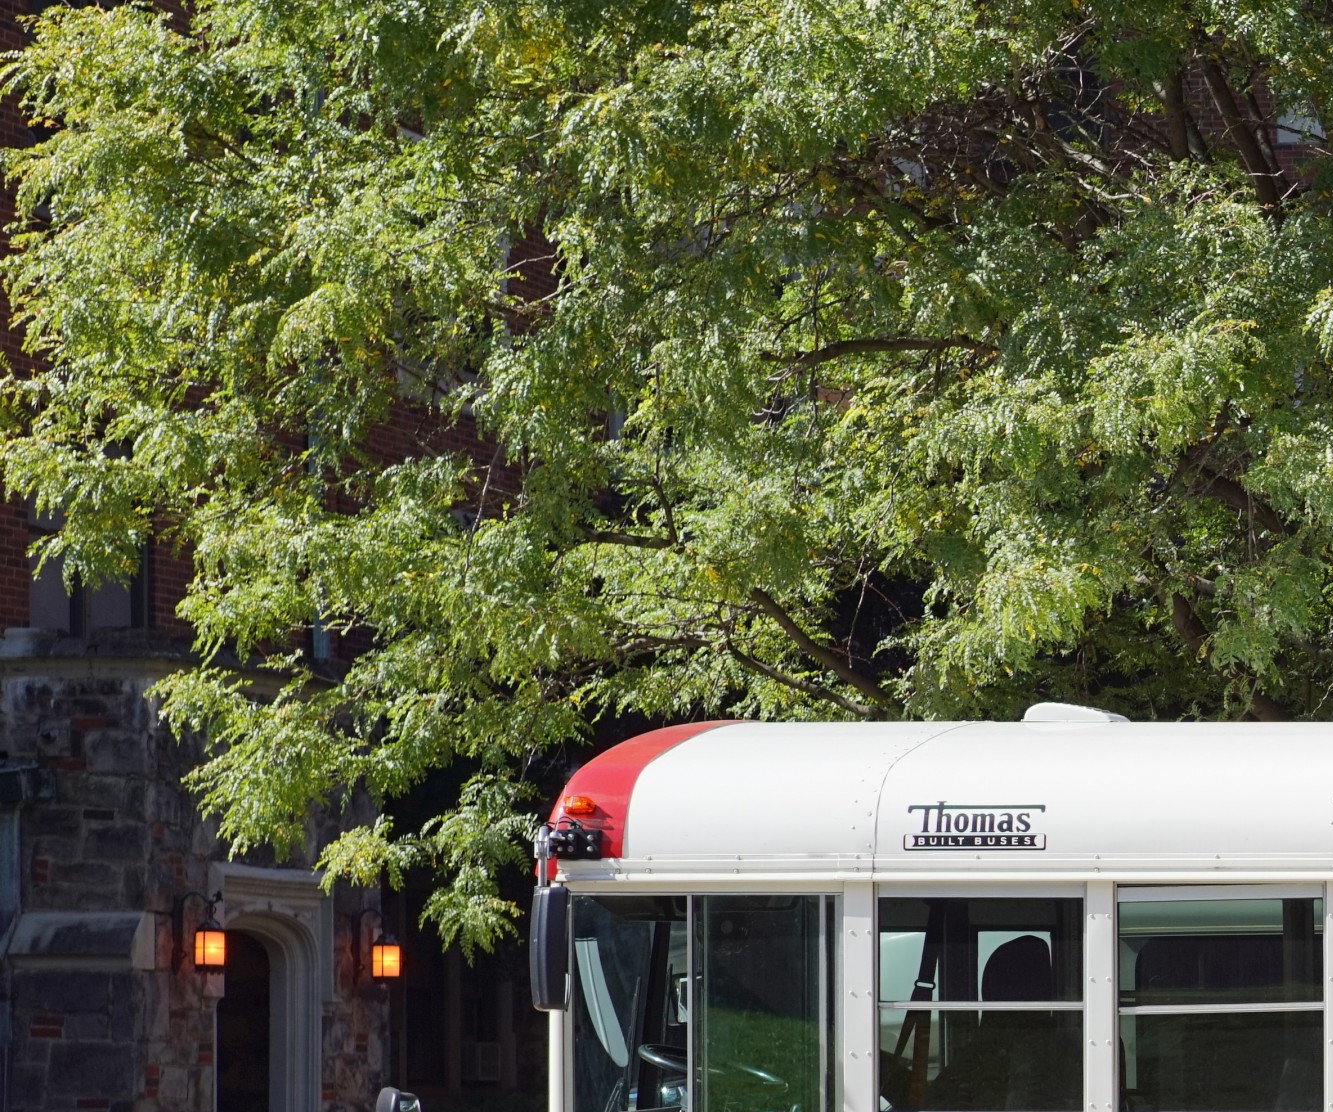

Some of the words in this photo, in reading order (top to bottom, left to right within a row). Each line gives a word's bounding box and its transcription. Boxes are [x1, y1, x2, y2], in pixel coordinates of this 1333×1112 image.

[908, 801, 1046, 833] Thomas
[917, 836, 965, 846] BUILT
[974, 836, 1031, 846] BUSES
